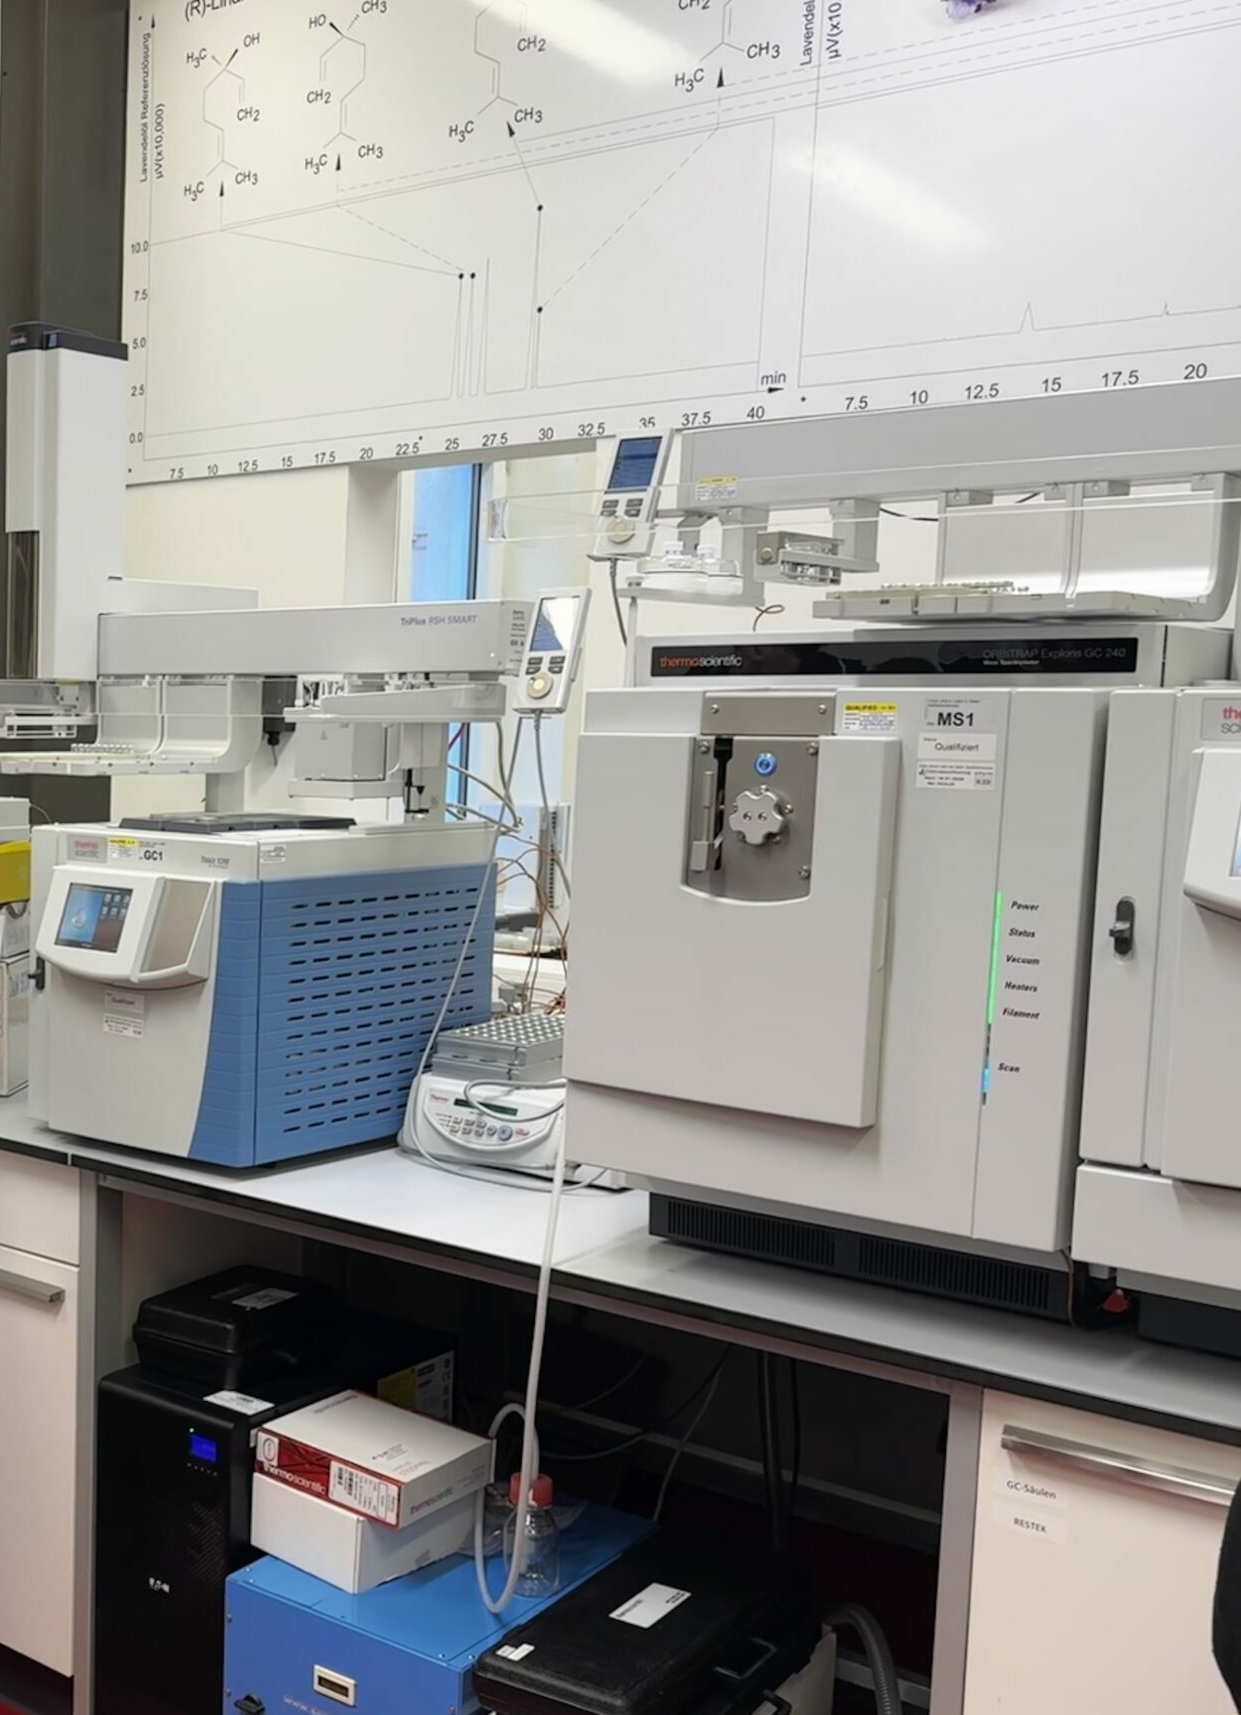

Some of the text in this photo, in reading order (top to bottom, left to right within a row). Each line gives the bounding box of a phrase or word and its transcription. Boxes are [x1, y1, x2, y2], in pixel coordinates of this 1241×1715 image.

[361, 0, 387, 14] CH3
[308, 14, 327, 30] HO
[243, 32, 260, 48] OH
[517, 35, 547, 52] CH2
[746, 41, 780, 59] CH3
[186, 48, 208, 69] H3C
[674, 68, 705, 92] H3C
[306, 88, 331, 104] CH2
[237, 107, 260, 122] CH2
[514, 106, 543, 123] CH3
[448, 120, 475, 143] H3C
[357, 144, 384, 160] CH3
[304, 153, 327, 175] H3C
[235, 170, 258, 186] CH3
[183, 181, 204, 202] H3C
[134, 288, 148, 302] 7.5
[132, 337, 146, 350] 5.0
[761, 371, 787, 386] min
[131, 384, 145, 397] 2.5
[845, 362, 1208, 412] 7.5 10 12.5 15 17.5 20
[129, 431, 144, 445] 0.0
[169, 405, 766, 480] 7.5 10 12.5 15 17.5 20 22.5 25 27.5 30 32.5 35 37.5 40
[447, 614, 478, 625] SMART
[659, 654, 742, 669] thermoscientific
[937, 711, 974, 727] MS1
[934, 742, 979, 752] Qualifiziert
[144, 850, 163, 861] GC1
[1010, 901, 1040, 912] Power
[1008, 927, 1036, 938] Status
[1006, 954, 1040, 966] Vacuum
[1004, 981, 1038, 993] Heaters
[1002, 1007, 1041, 1020] Filament
[997, 1062, 1020, 1073] Scan
[1006, 1479, 1057, 1500] GC-Säulen
[1013, 1517, 1047, 1534] RESTEK
